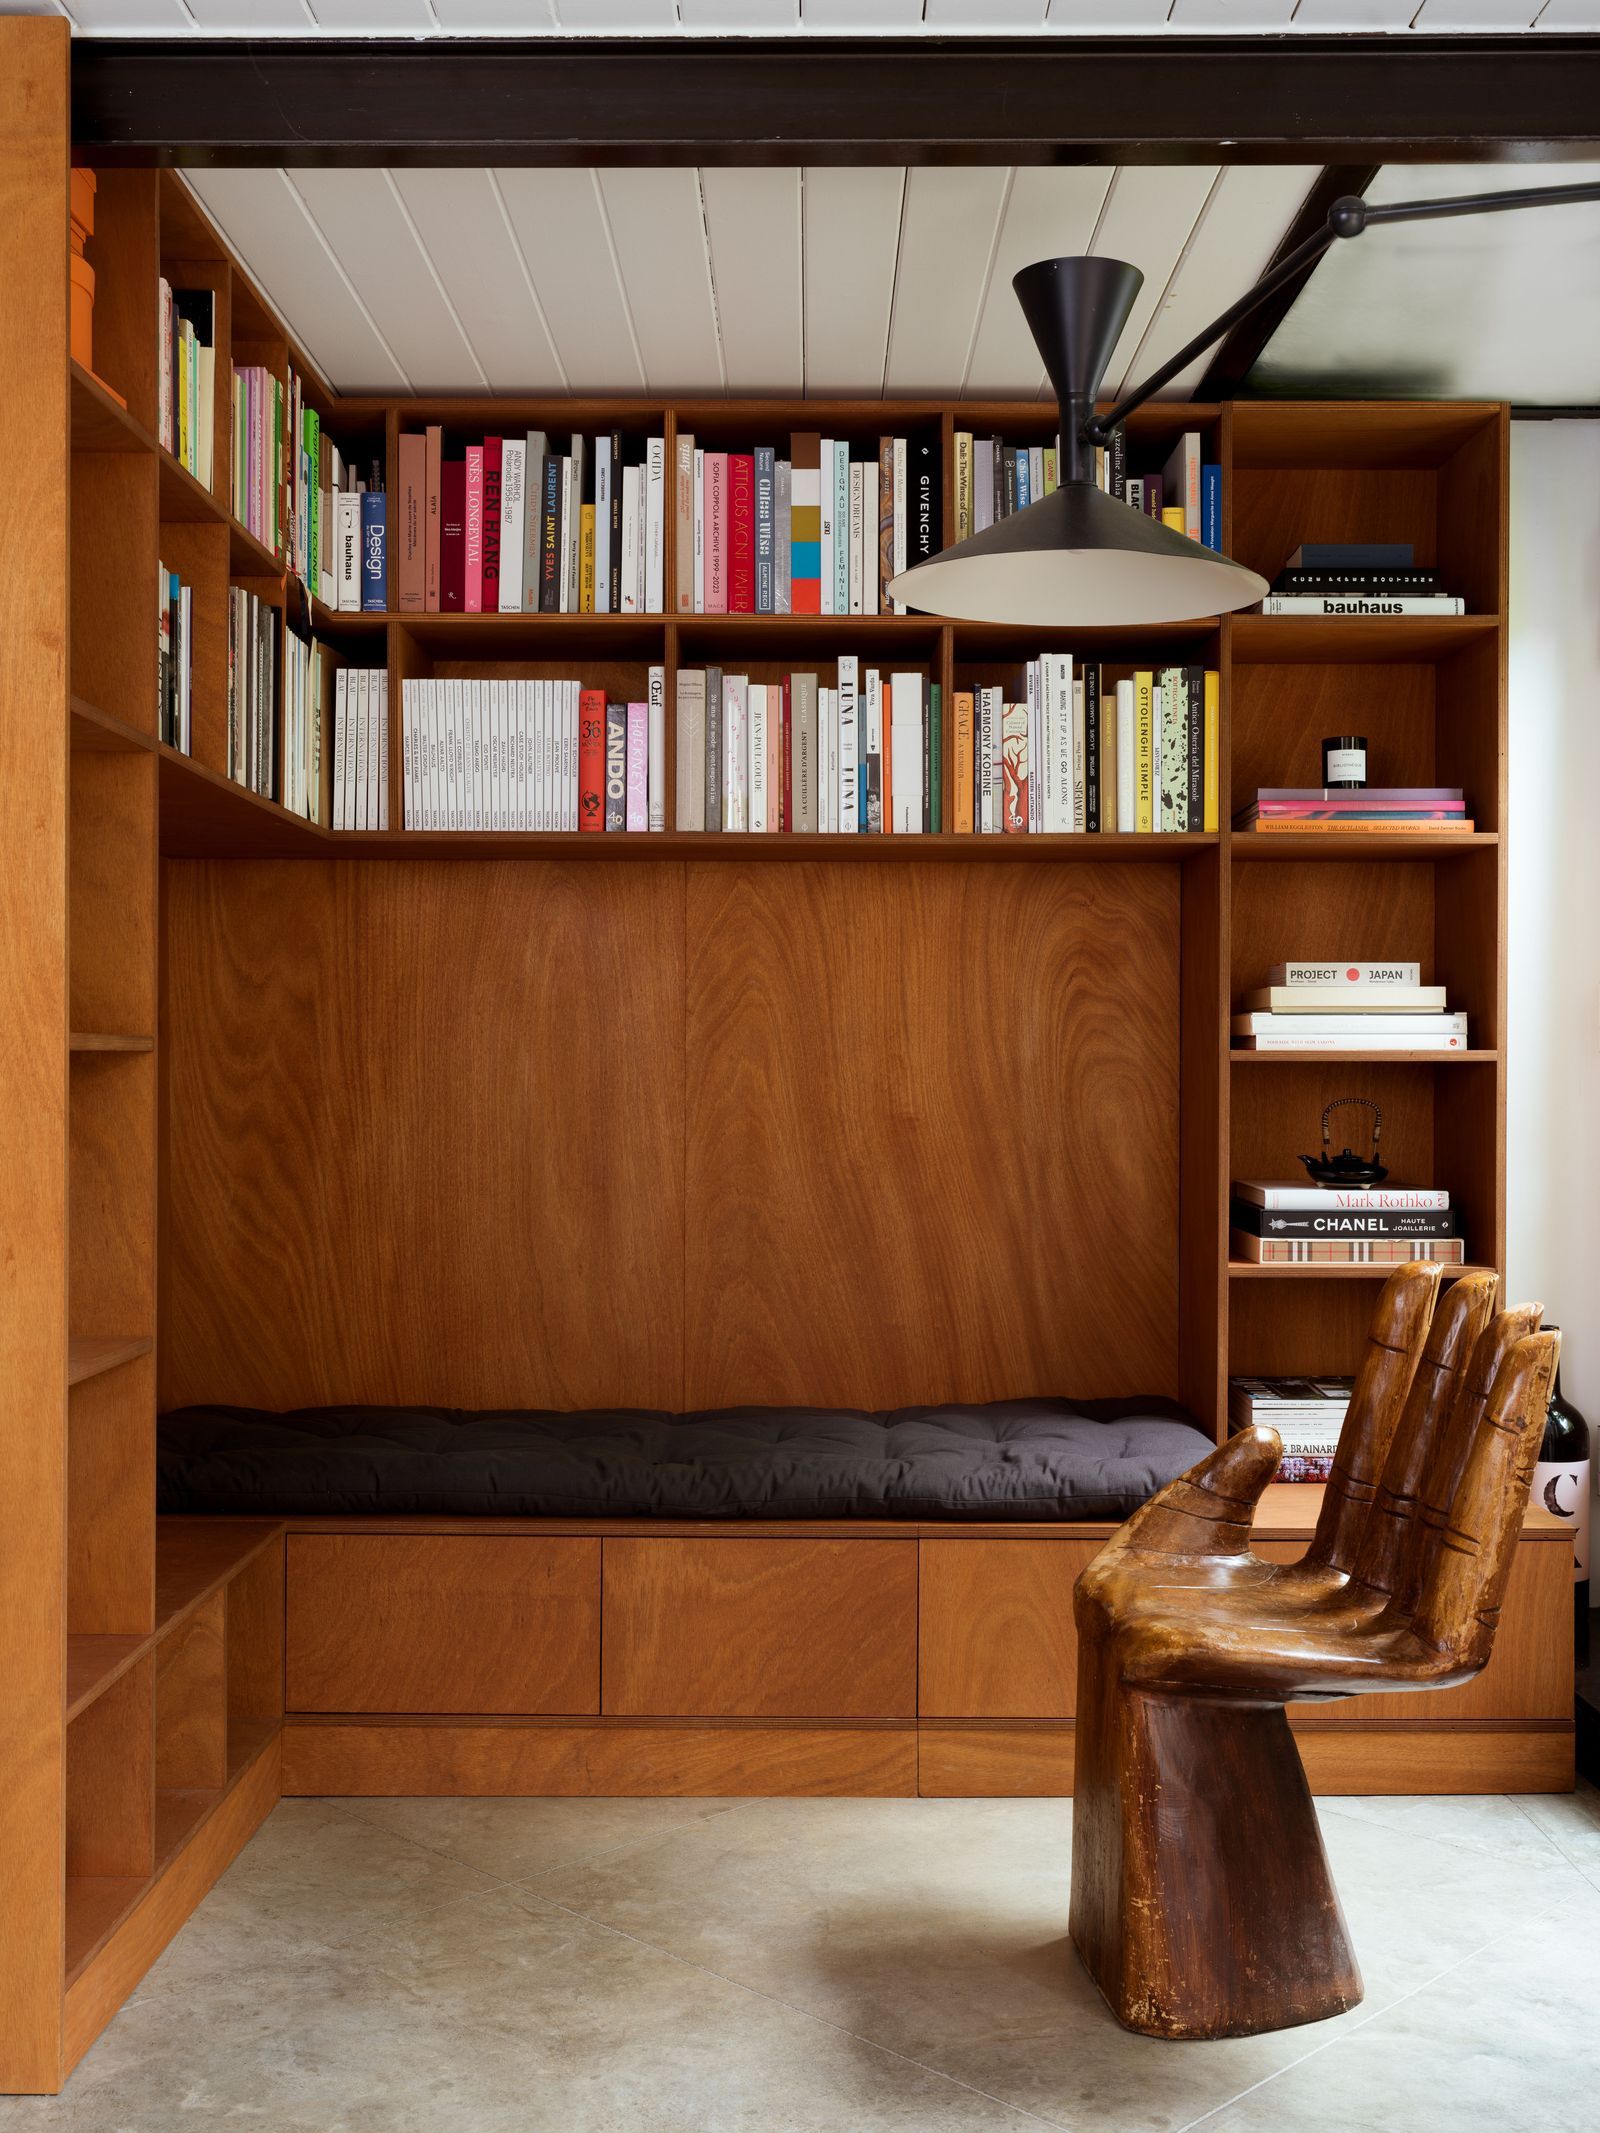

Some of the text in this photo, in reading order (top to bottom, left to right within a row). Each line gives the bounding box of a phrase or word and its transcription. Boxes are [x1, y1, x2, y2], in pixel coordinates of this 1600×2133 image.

[504, 450, 514, 482] Polaroids
[512, 450, 522, 503] ANDY WARHOL
[679, 443, 690, 475] Amis
[1114, 431, 1123, 496] Azzedine Alaïa
[547, 462, 557, 513] LAURENT
[734, 458, 749, 517] ATTICUS
[839, 496, 846, 508] AU
[960, 502, 967, 510] of
[468, 453, 482, 566] INÈS LONGEVIAL
[484, 470, 500, 579] REN HANG
[920, 476, 929, 554] GIVENCHY
[370, 524, 385, 580] Design
[546, 516, 556, 549] SAINT
[345, 535, 354, 581] bauhaus
[545, 552, 555, 580] YVES
[1323, 600, 1403, 614] bauhaus
[710, 694, 717, 703] 20
[841, 682, 854, 726] LUNA
[582, 720, 601, 739] 36
[710, 720, 717, 728] de
[958, 700, 969, 740] GRACE
[1060, 736, 1067, 746] AS
[347, 718, 355, 784] INTERNATIONAL
[358, 717, 366, 784] INTERNATIONAL
[608, 722, 624, 799] ANDO
[754, 712, 762, 792] JEAN-PAUL GOUDE
[982, 692, 991, 797] HARMONY KORINE
[1060, 749, 1067, 758] WE
[1191, 700, 1200, 802] Antica Osteria del Mirasole
[1060, 761, 1067, 774] GO
[842, 767, 854, 811] LUNA
[1074, 780, 1083, 826] FLOWERS
[1290, 970, 1337, 979] PROJECT
[1369, 970, 1403, 979] JAPAN
[1335, 1193, 1433, 1208] Mark Rothko
[1314, 1218, 1388, 1231] CHANEL
[1291, 1445, 1337, 1454] BRAINARD
